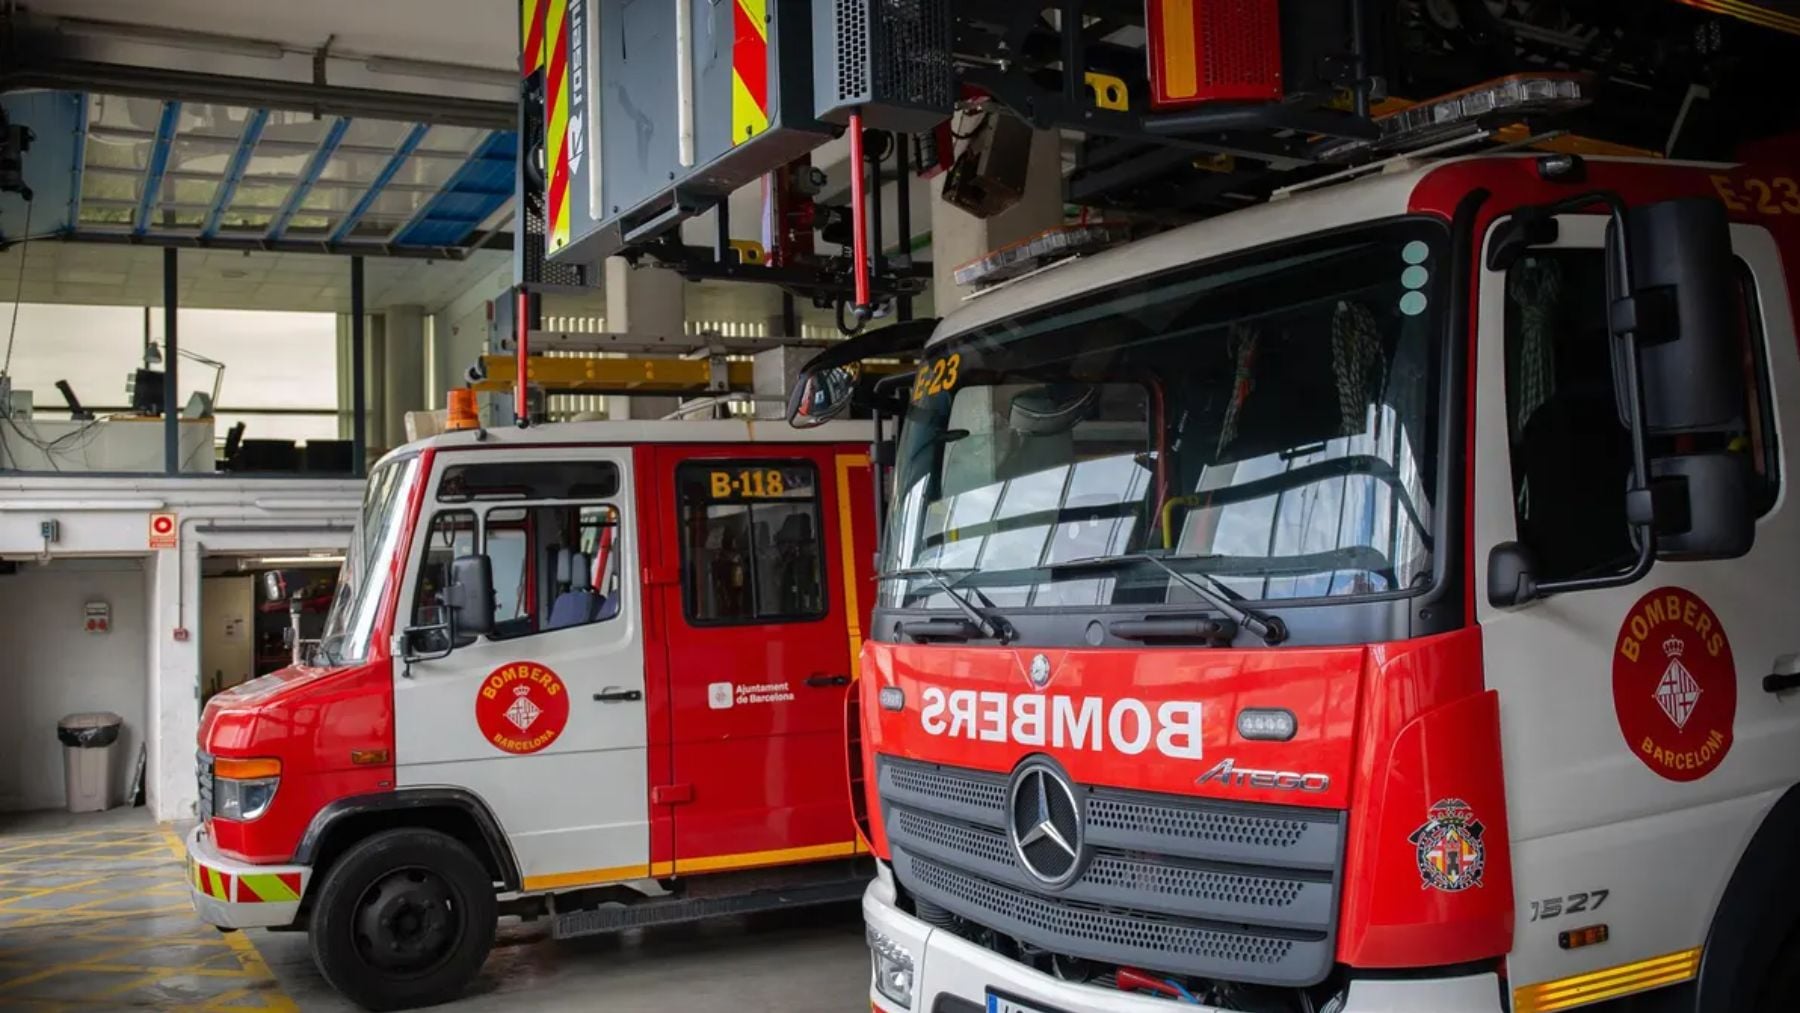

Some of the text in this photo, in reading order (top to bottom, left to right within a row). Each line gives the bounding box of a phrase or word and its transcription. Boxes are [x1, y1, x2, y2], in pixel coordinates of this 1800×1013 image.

[1709, 174, 1800, 214] E-23
[912, 352, 961, 402] E-23
[1621, 595, 1724, 663] BOMBERS
[482, 665, 561, 700] BOMBERS
[736, 682, 789, 695] Ajuntament
[736, 693, 794, 704] de Barcelona
[493, 729, 555, 750] BARCELONA
[1641, 728, 1724, 770] BARCELONA
[1195, 757, 1329, 793] ATEGO
[1530, 889, 1609, 922] 1527
